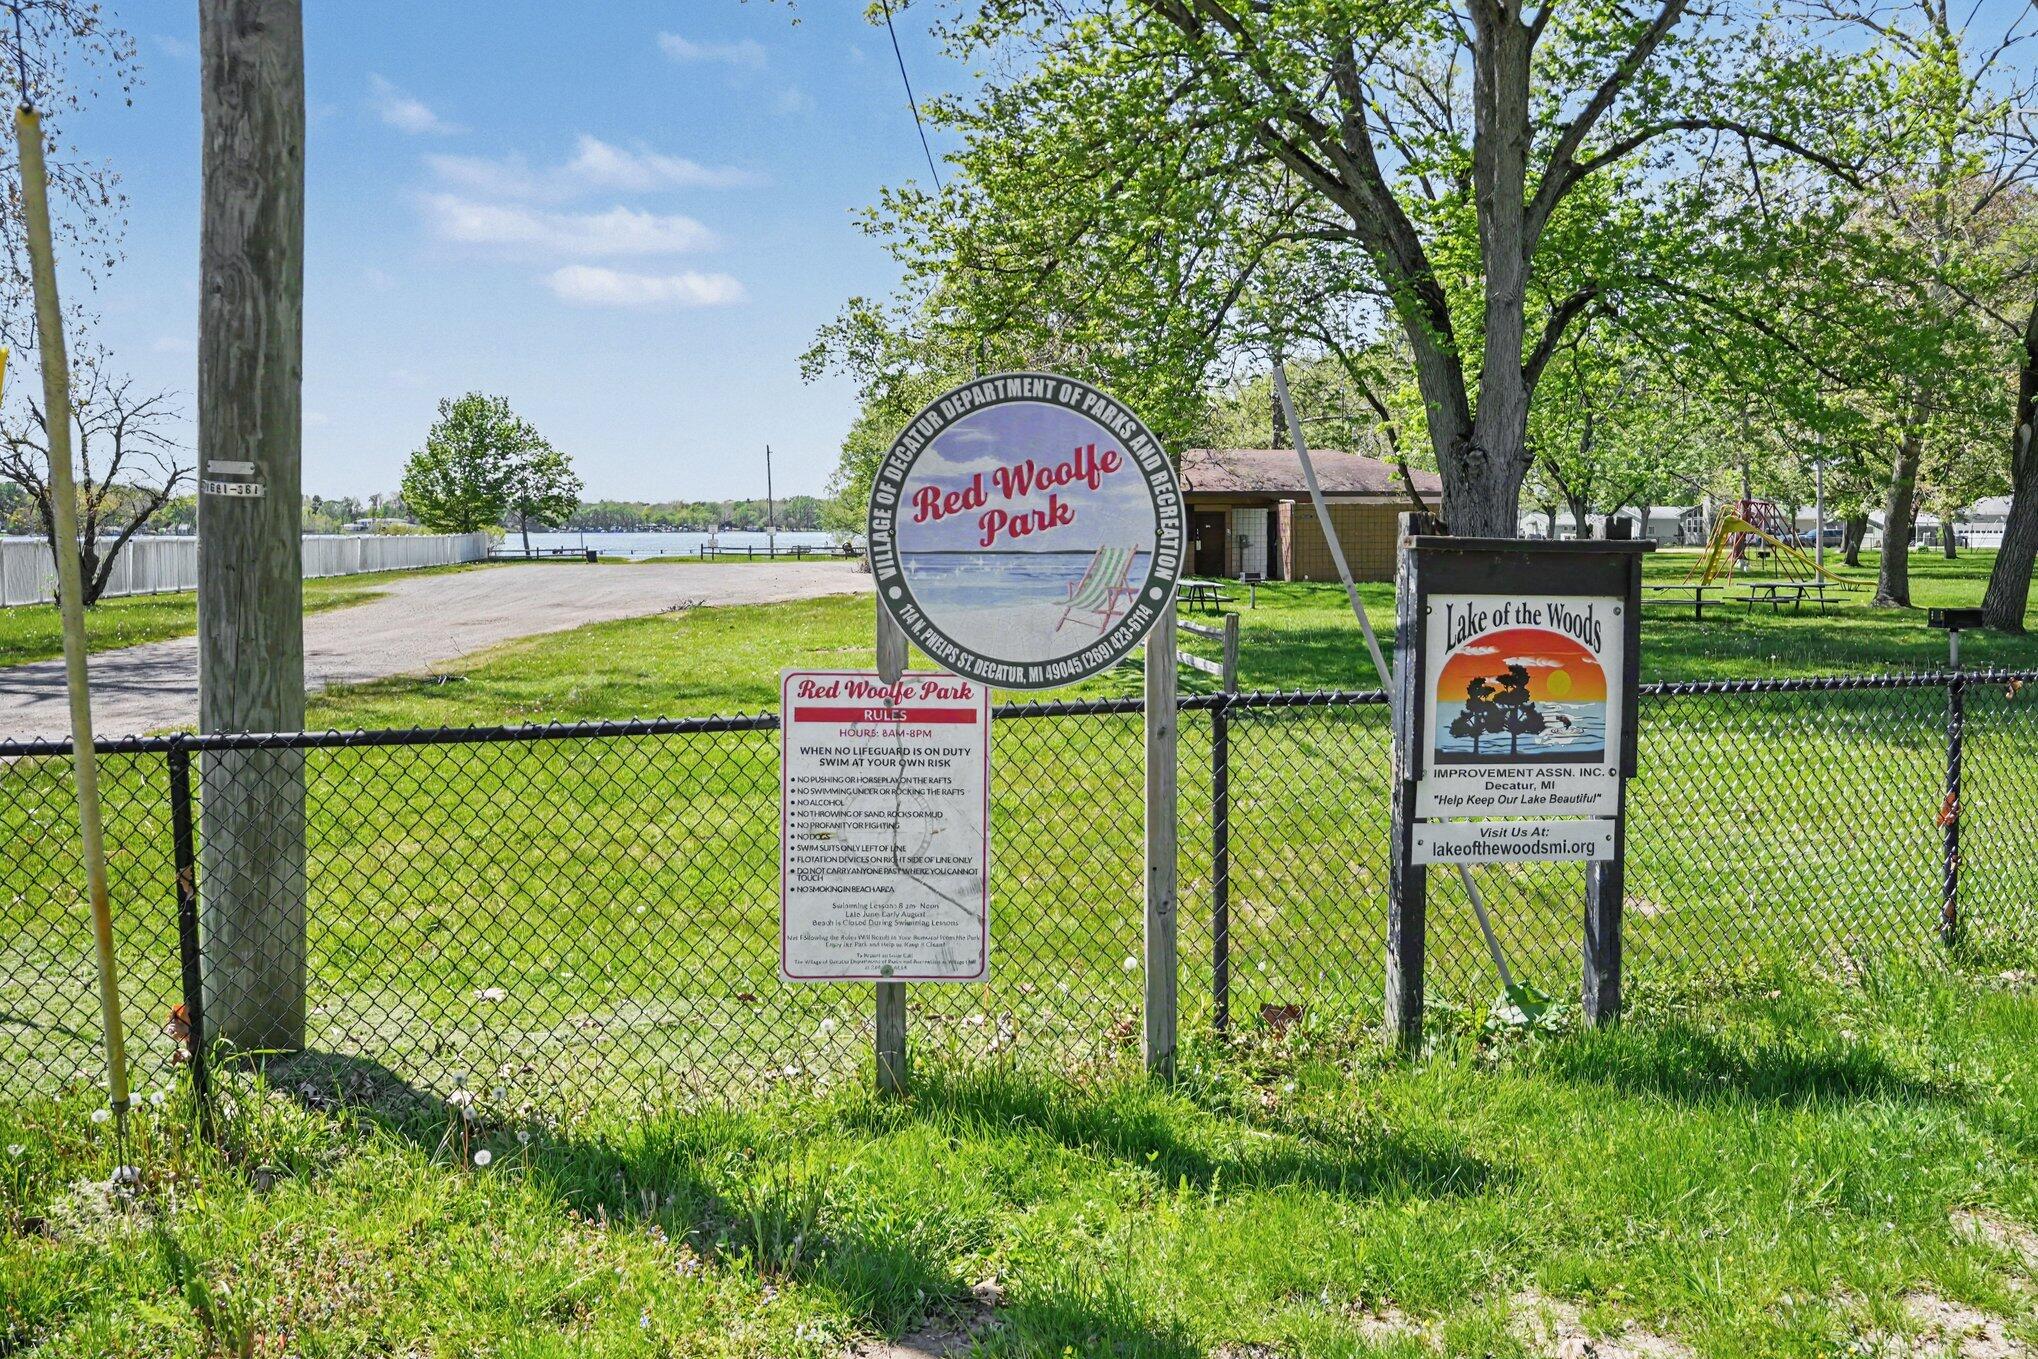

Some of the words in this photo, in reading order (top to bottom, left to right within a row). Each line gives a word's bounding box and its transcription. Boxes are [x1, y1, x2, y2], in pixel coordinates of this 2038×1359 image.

[940, 377, 1057, 420] DEPARTMENT
[1058, 383, 1083, 407] OF
[1081, 394, 1137, 440] PARKS
[883, 411, 945, 483] DECATUR
[1128, 434, 1163, 472] AND
[876, 481, 898, 506] OF
[912, 473, 988, 523] Red
[992, 443, 1123, 500] Woolfe
[978, 494, 1075, 548] Park
[1150, 469, 1179, 582] RECREATION
[872, 507, 897, 582] VILLAGE
[1445, 601, 1487, 655] Lake
[1493, 602, 1511, 627] of
[1515, 602, 1541, 625] the
[1547, 602, 1601, 654] Woods
[900, 603, 919, 625] 114
[911, 619, 927, 636] N.
[920, 627, 960, 664] PHELPS
[957, 651, 975, 672] ST.
[973, 659, 1027, 684] DECATUR,
[1028, 666, 1044, 683] MI
[1045, 656, 1083, 680] 49045
[1081, 641, 1115, 669] (269)
[1110, 603, 1153, 649] 423-6114
[798, 680, 841, 699] Red
[845, 680, 916, 705] Woolfe
[920, 681, 974, 700] Park
[864, 709, 907, 721] RULES
[840, 729, 879, 738] HOURS:
[882, 729, 932, 738] 8AM-8PM
[800, 747, 832, 755] WHEN
[835, 747, 850, 756] NO
[853, 748, 910, 756] LIFEGUARD
[913, 748, 922, 756] IS
[924, 748, 940, 757] ON
[943, 748, 971, 757] DUTY
[819, 758, 849, 767] SWIM
[852, 759, 864, 767] AT
[868, 759, 896, 768] YOUR
[899, 759, 925, 768] OWN
[928, 760, 951, 768] RISK
[1434, 768, 1537, 778] IMPROVEMENT
[1538, 768, 1575, 777] ASSN.
[1579, 767, 1605, 777] INC.
[1485, 781, 1537, 791] Decatur,
[1541, 781, 1555, 790] MI
[1434, 795, 1463, 807] "Help
[1467, 795, 1494, 807] Keep
[1498, 795, 1518, 804] Our
[1521, 794, 1546, 804] Lake
[1480, 828, 1507, 838] Visit
[1512, 828, 1527, 837] Us
[1531, 827, 1550, 837] At:
[1433, 840, 1595, 857] lakeofthewoodsmi.org
